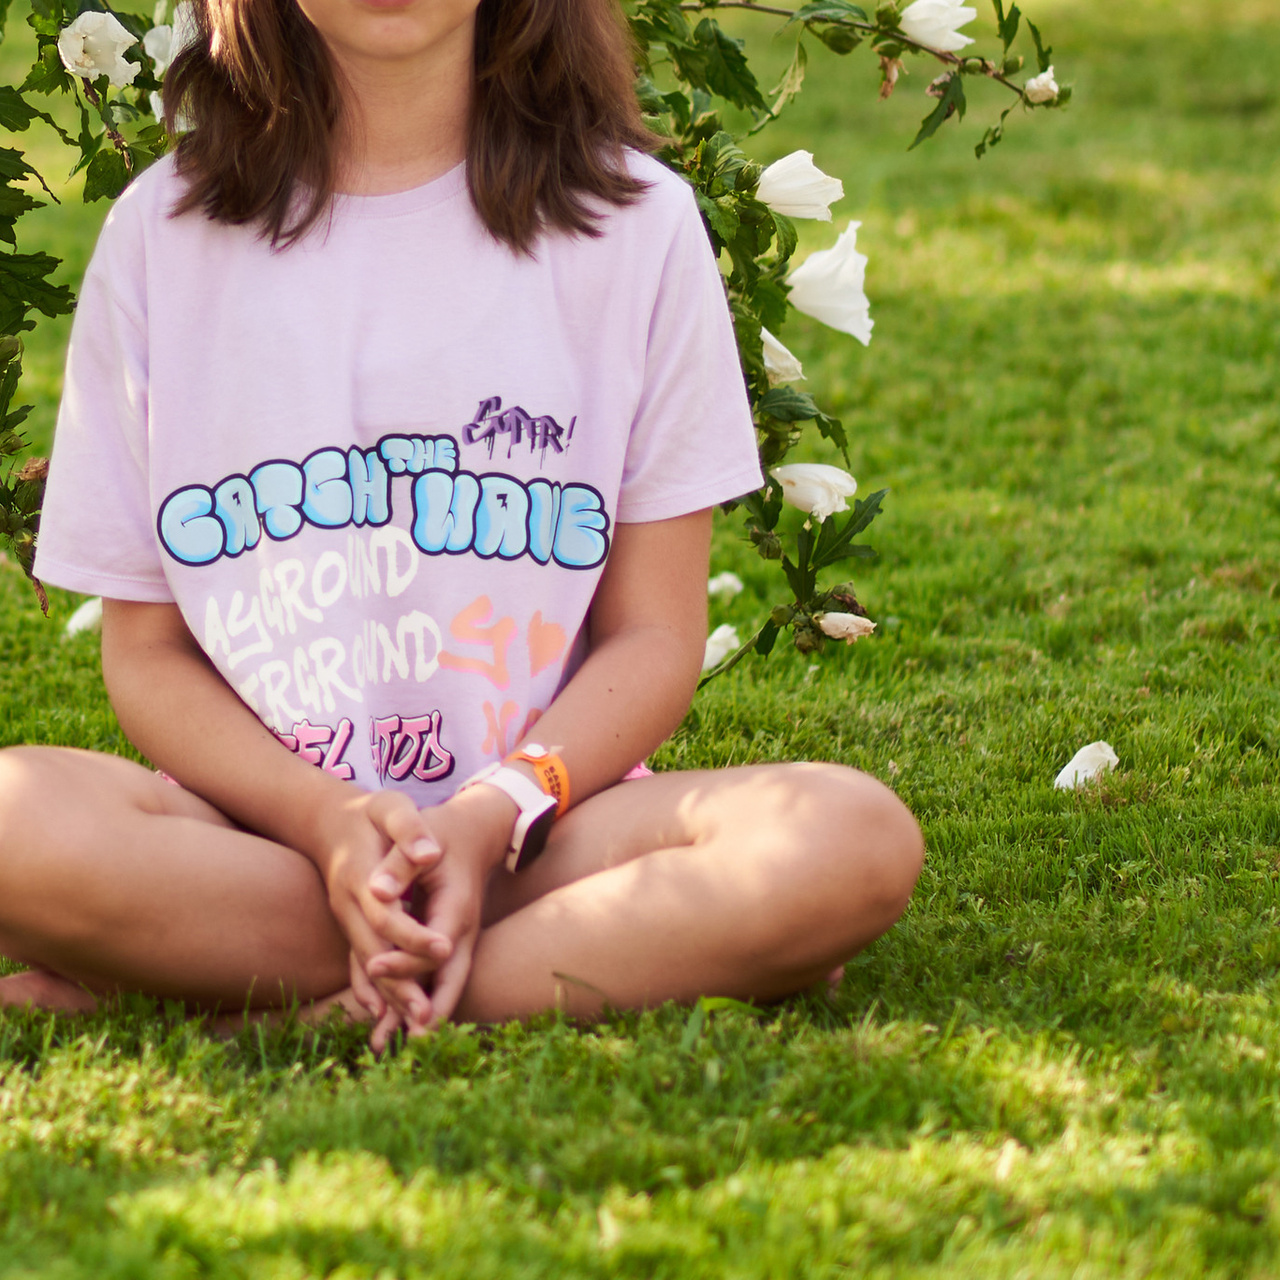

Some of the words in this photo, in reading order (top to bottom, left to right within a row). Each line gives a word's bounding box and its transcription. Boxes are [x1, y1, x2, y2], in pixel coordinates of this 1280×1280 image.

[157, 444, 393, 567] CATCH
[376, 433, 460, 477] THE
[410, 468, 611, 570] WAVE
